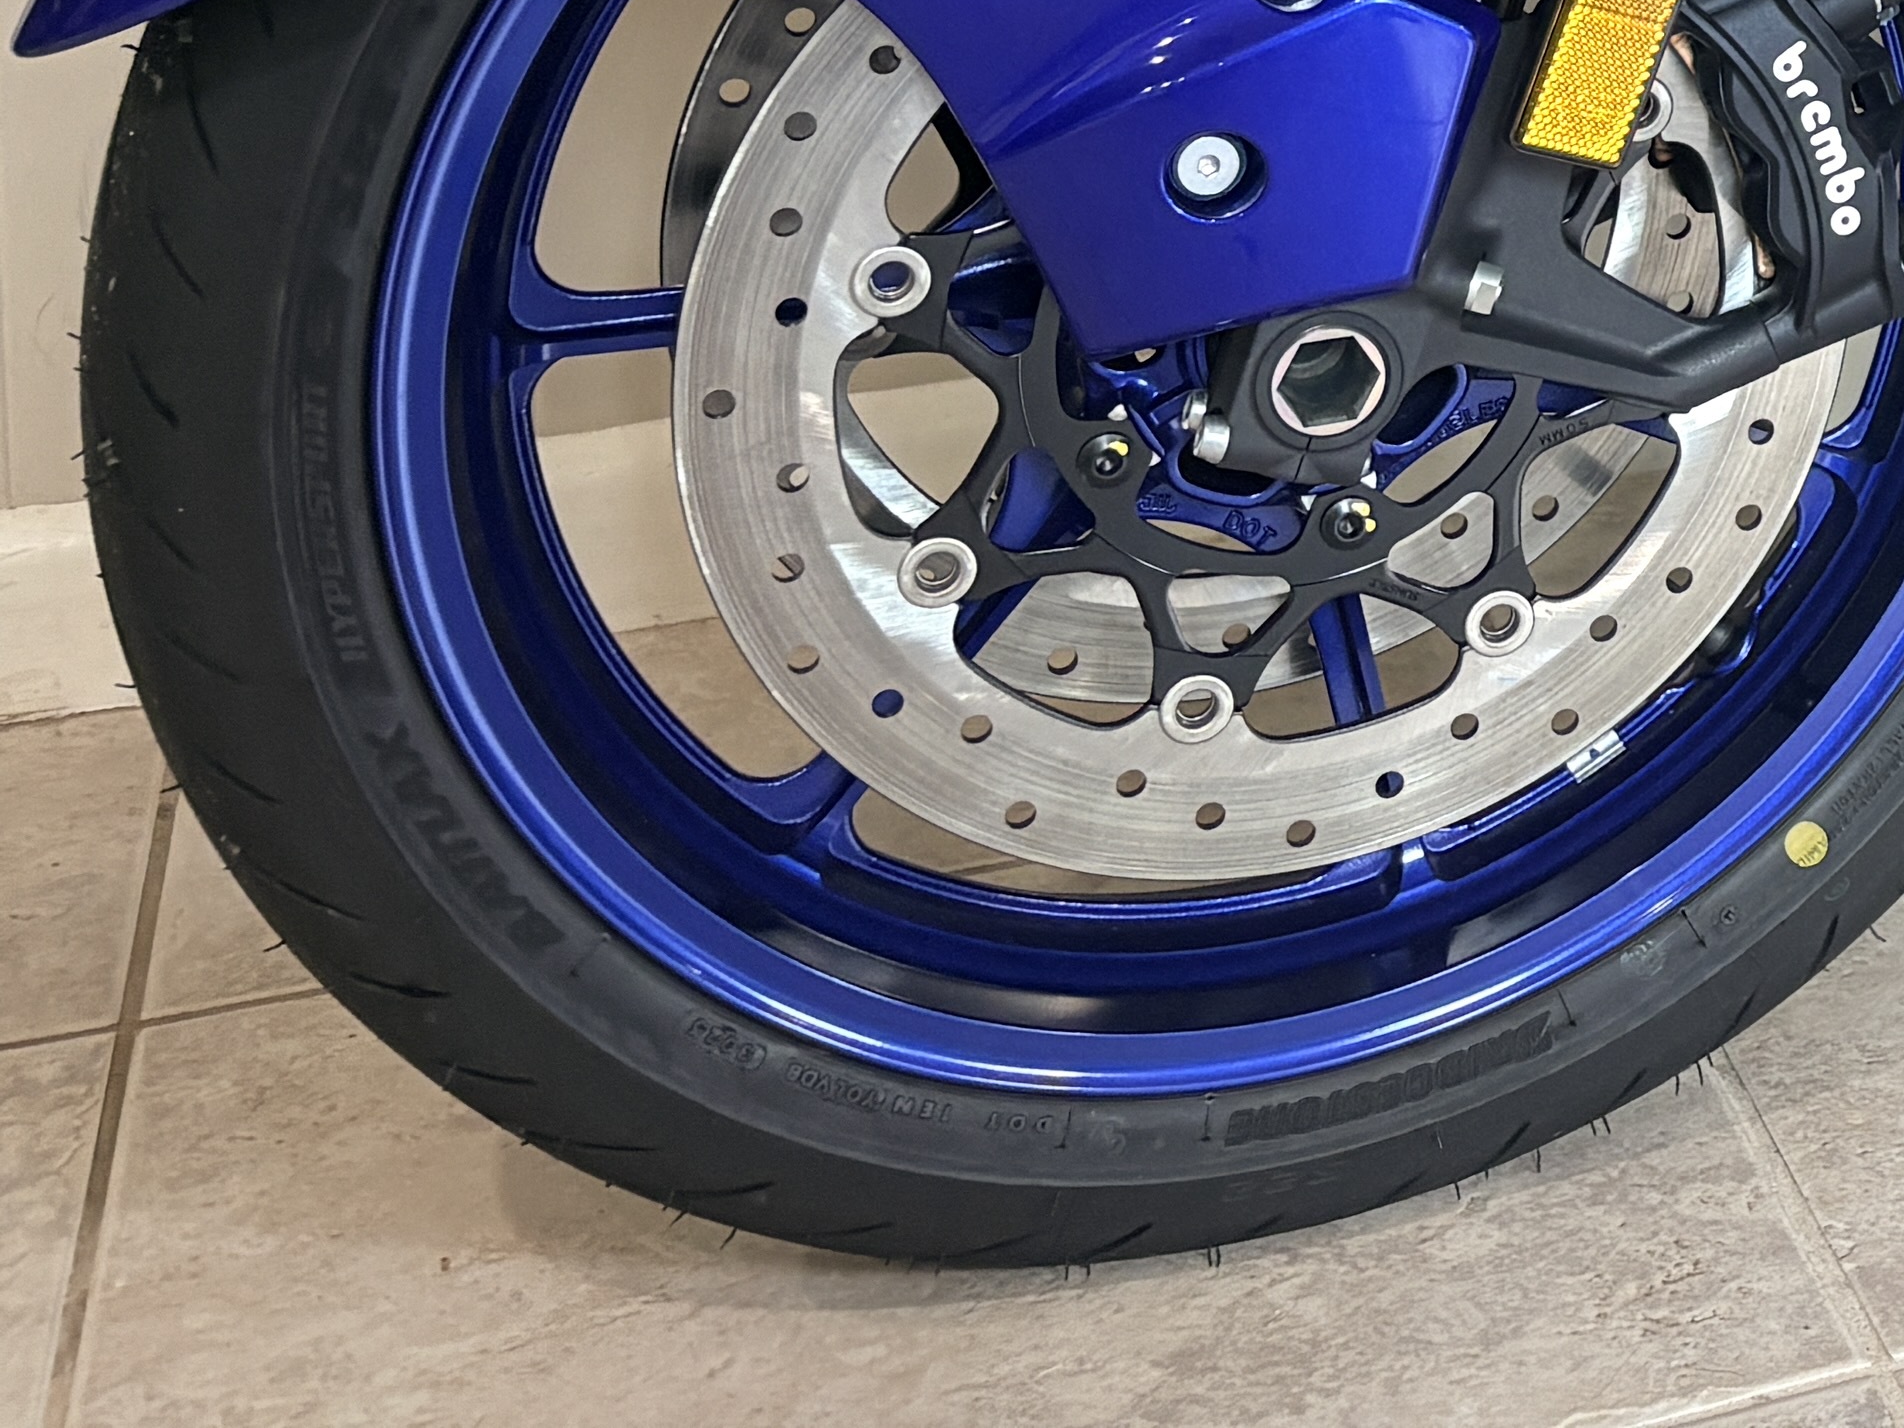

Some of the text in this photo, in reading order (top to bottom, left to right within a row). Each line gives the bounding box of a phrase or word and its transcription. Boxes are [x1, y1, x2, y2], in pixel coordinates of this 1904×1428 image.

[1773, 40, 1865, 236] brembo
[1537, 417, 1590, 445] 50MM
[1223, 509, 1278, 548] DOT
[982, 1111, 1054, 1135] DOT
